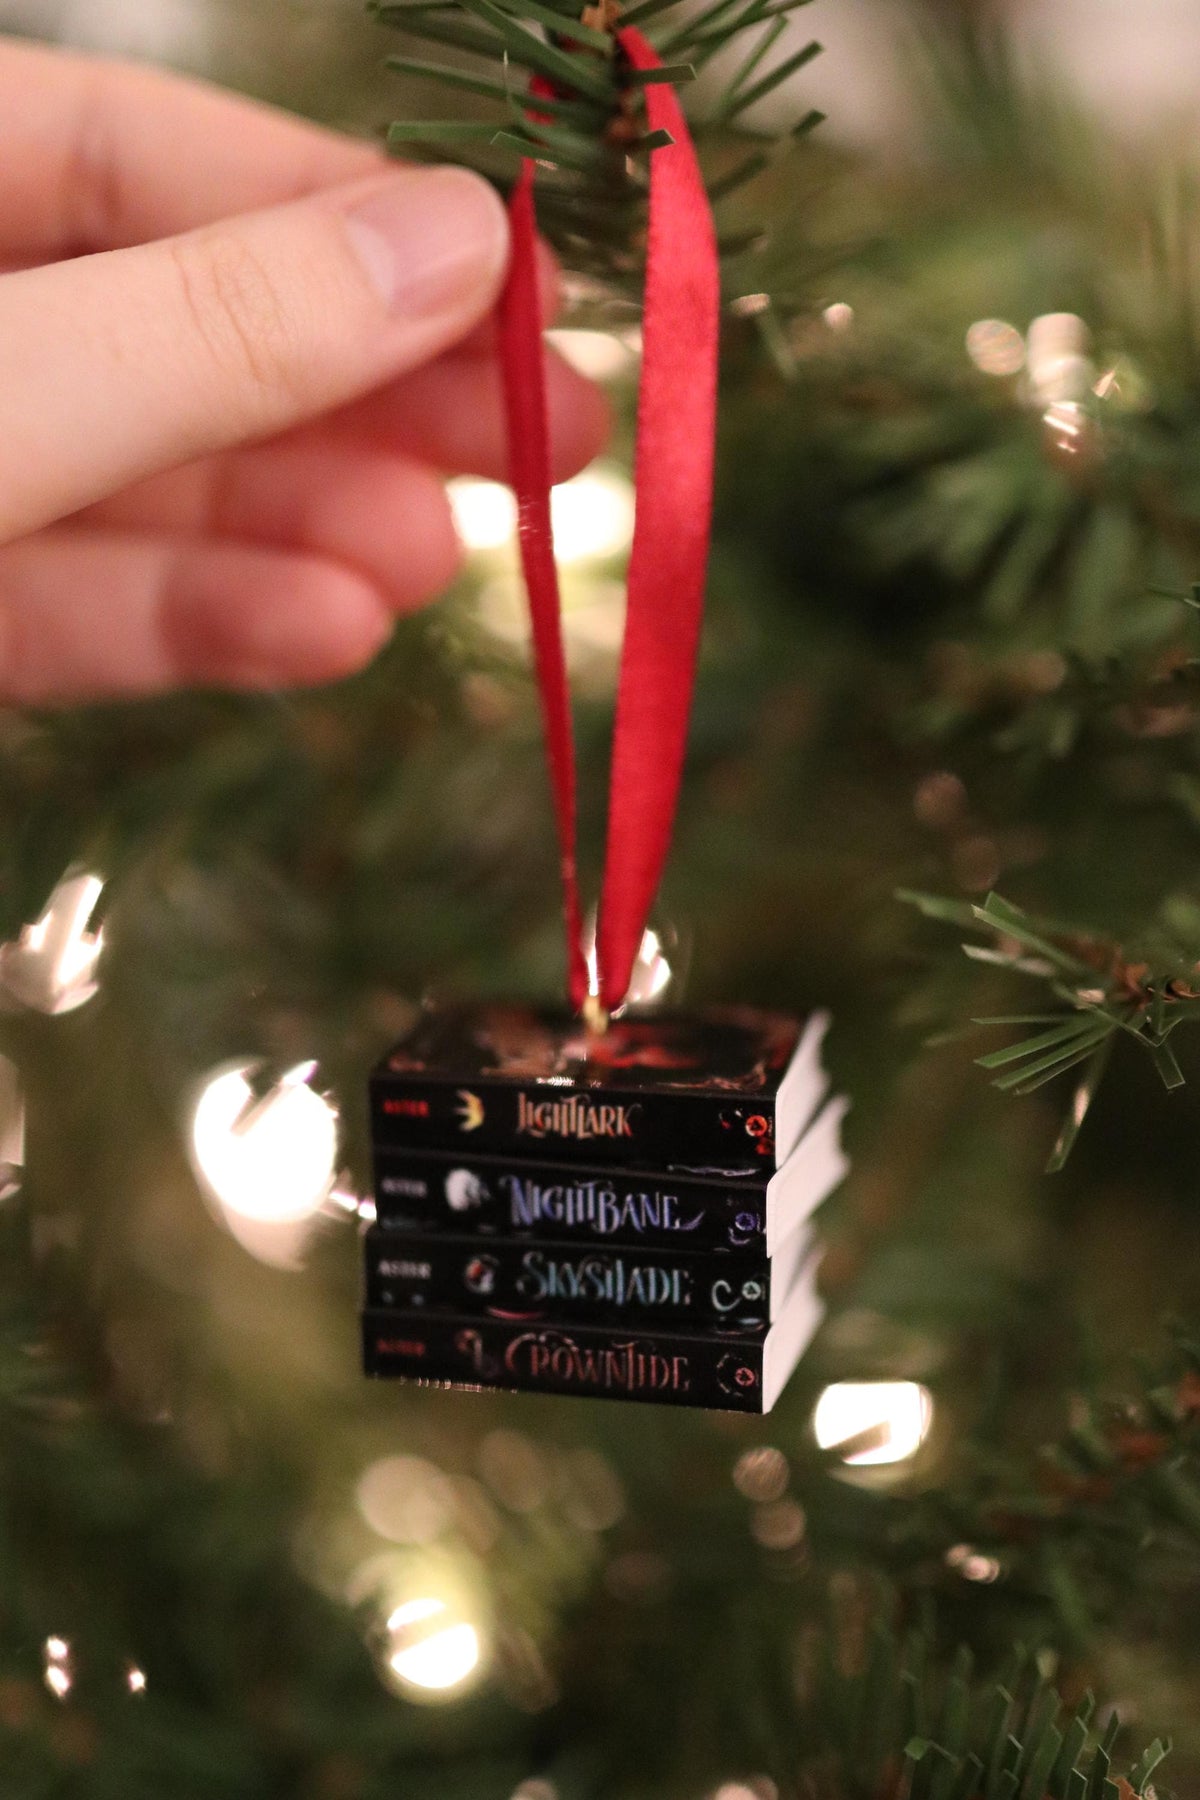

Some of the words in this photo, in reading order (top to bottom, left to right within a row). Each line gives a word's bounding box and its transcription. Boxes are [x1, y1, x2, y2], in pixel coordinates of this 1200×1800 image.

[516, 1092, 641, 1139] LIGHTLARK
[501, 1175, 704, 1234] NIGHTBANE
[517, 1251, 691, 1306] SKYSHADE
[505, 1331, 690, 1392] CROWNTIDE
